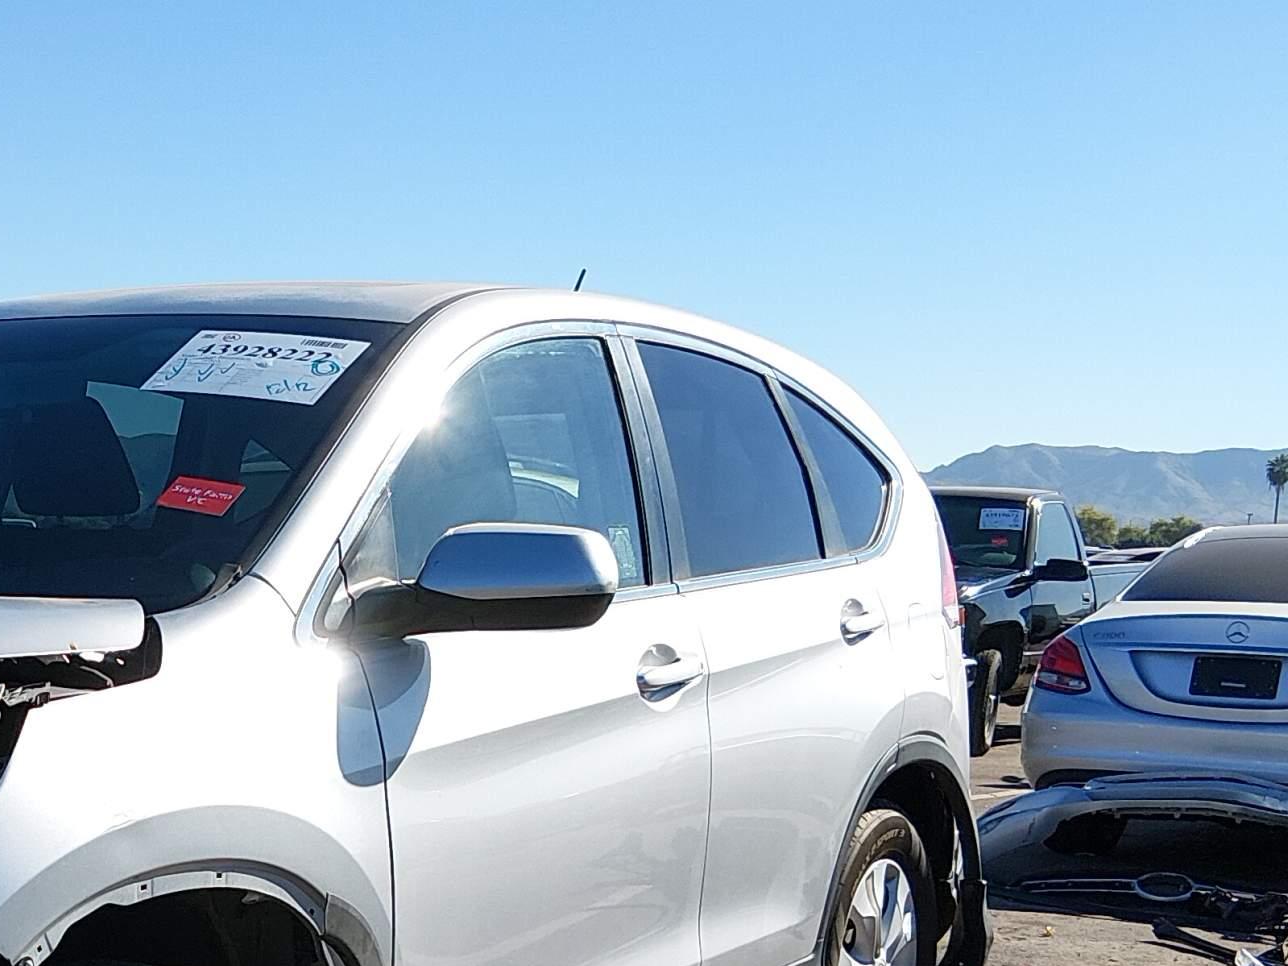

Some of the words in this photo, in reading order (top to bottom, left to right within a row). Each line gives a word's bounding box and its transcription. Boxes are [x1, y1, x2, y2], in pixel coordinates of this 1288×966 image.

[197, 343, 332, 363] 43928222
[172, 484, 202, 495] State
[203, 489, 233, 500] Farm
